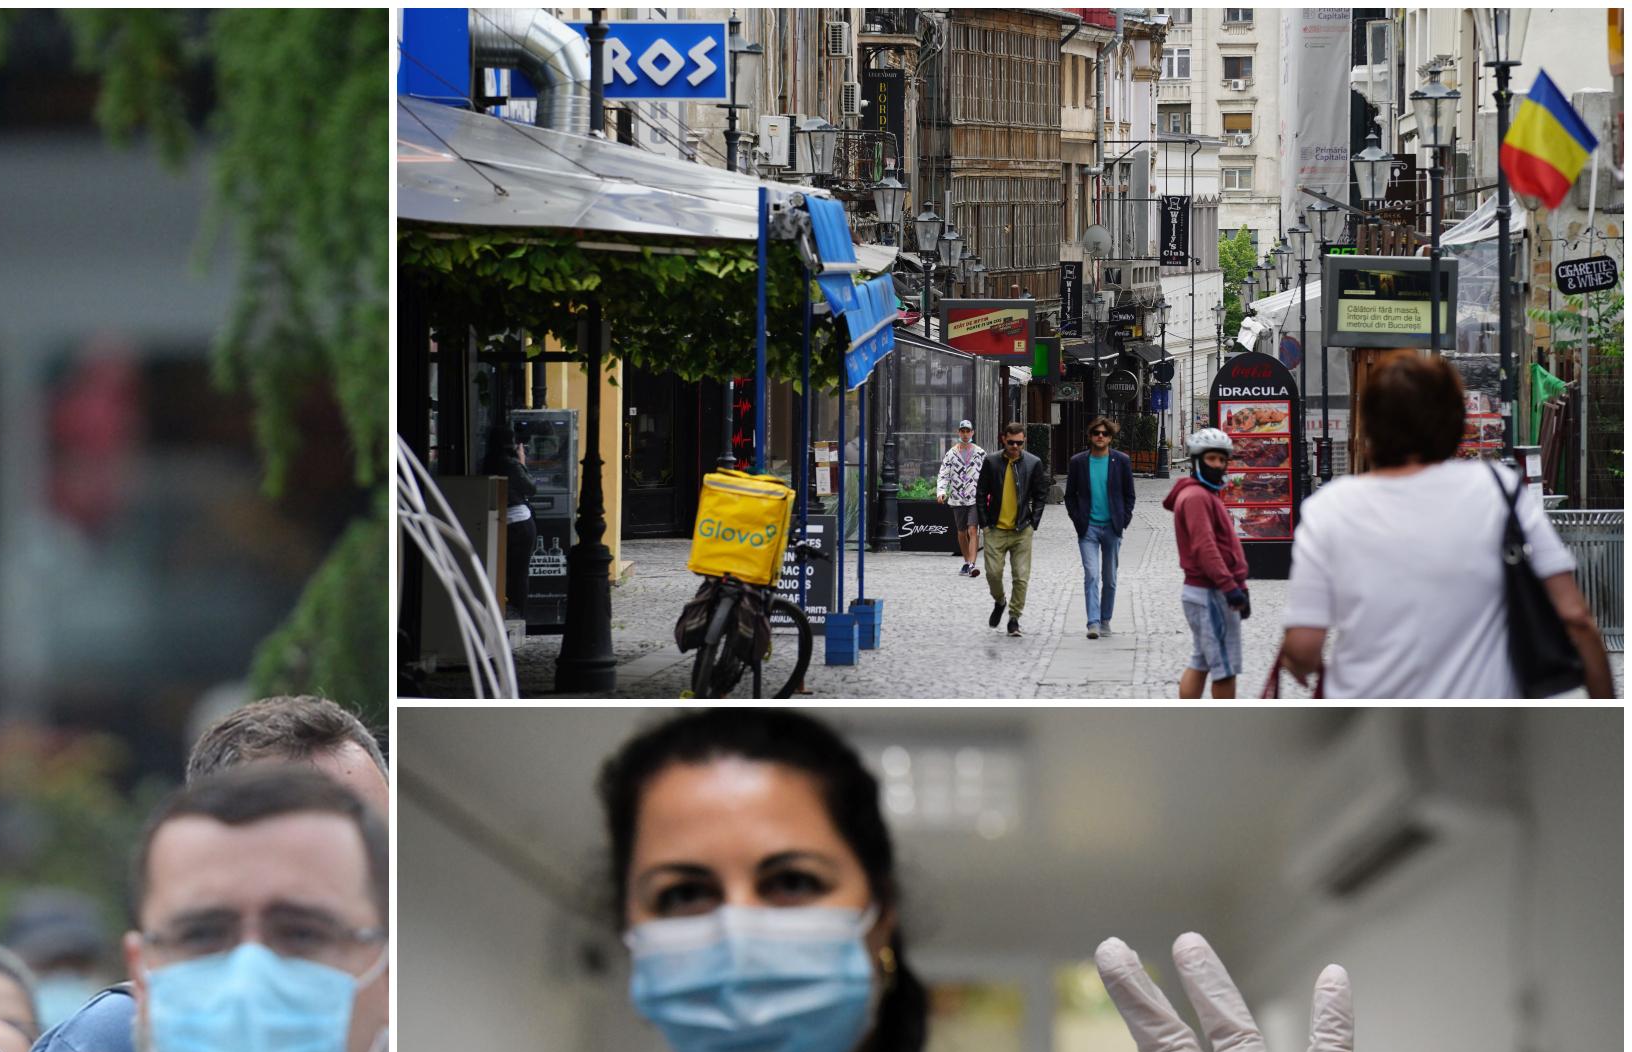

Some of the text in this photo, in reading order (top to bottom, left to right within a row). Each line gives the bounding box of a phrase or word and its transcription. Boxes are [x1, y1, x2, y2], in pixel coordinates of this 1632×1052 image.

[601, 36, 718, 87] ROS
[1558, 259, 1615, 278] CIGARETTES
[1577, 272, 1614, 288] WINES
[698, 518, 765, 547] Glovo
[805, 606, 827, 614] PIRITS
